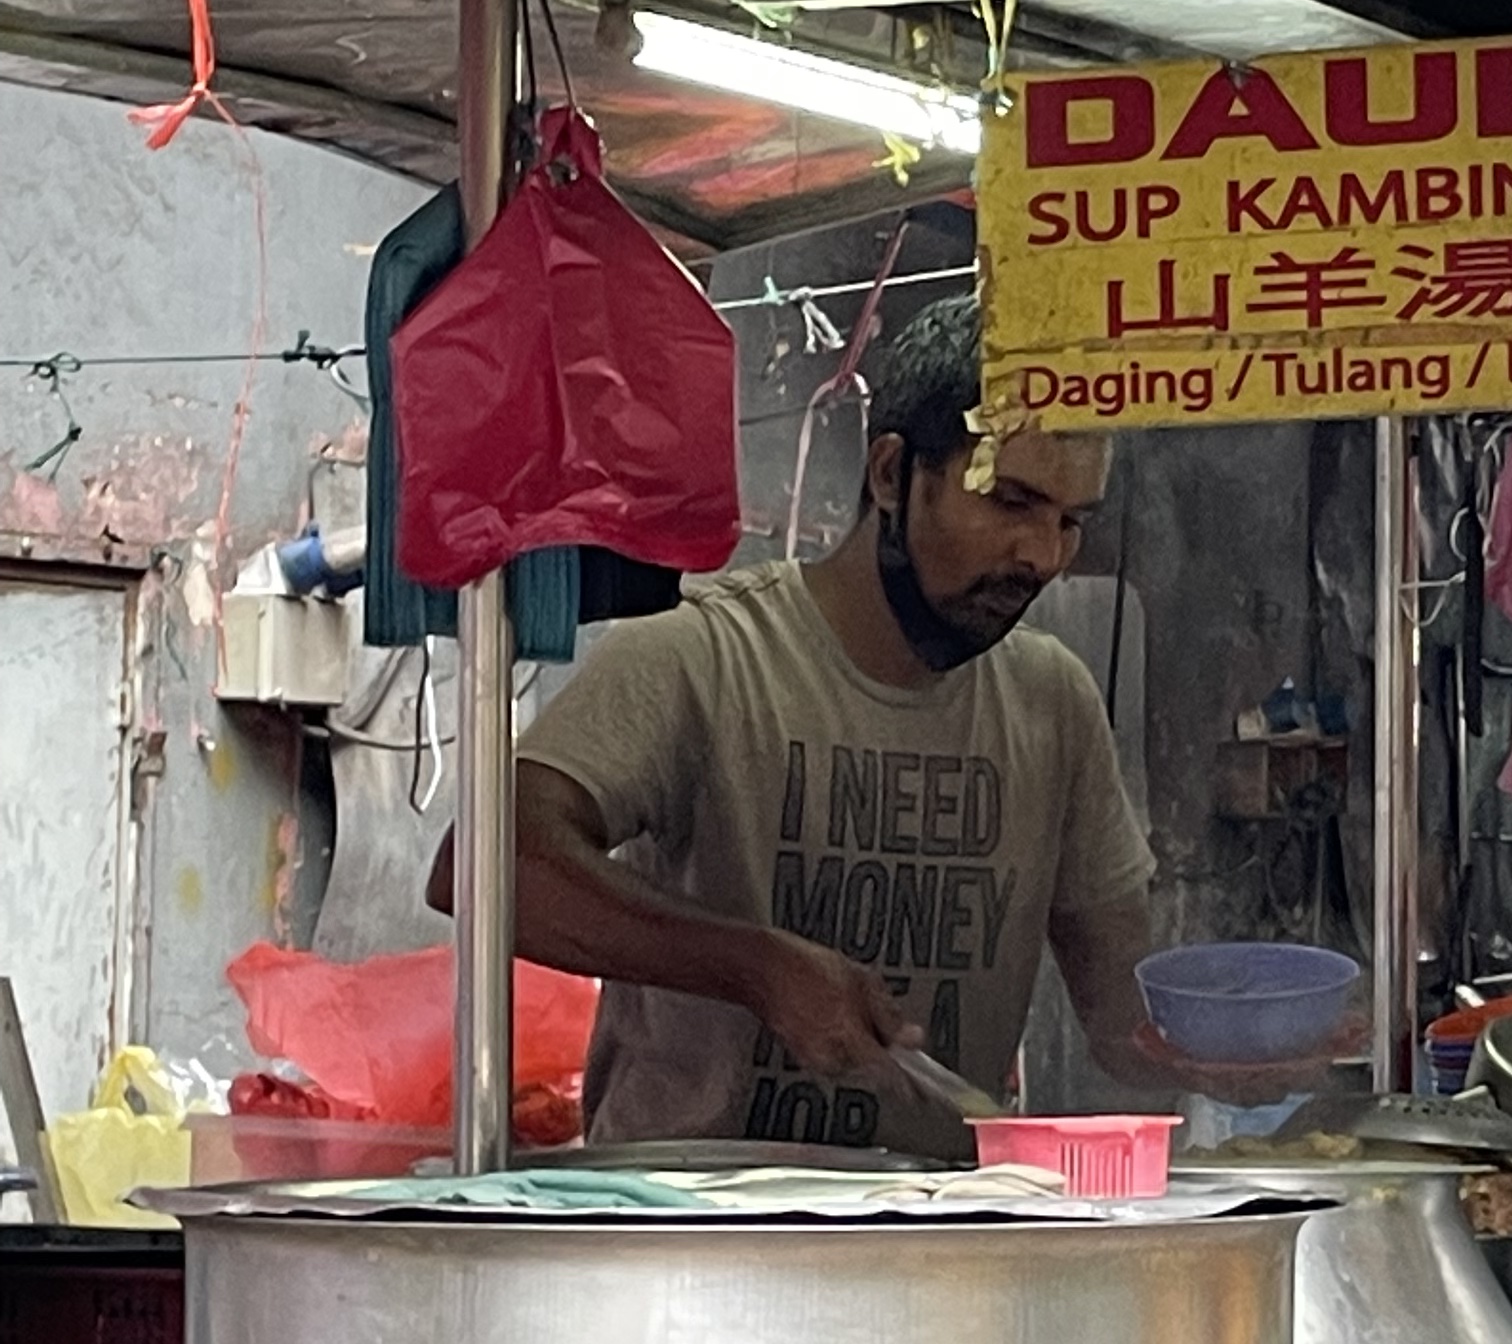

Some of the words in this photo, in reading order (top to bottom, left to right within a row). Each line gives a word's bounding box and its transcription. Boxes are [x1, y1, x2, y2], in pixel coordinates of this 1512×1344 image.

[1027, 184, 1182, 246] SUP
[1020, 362, 1214, 417] Daging
[1260, 348, 1451, 399] Tulang
[780, 740, 806, 842] I
[827, 744, 1002, 858] NEED
[772, 850, 1017, 970] MONEY
